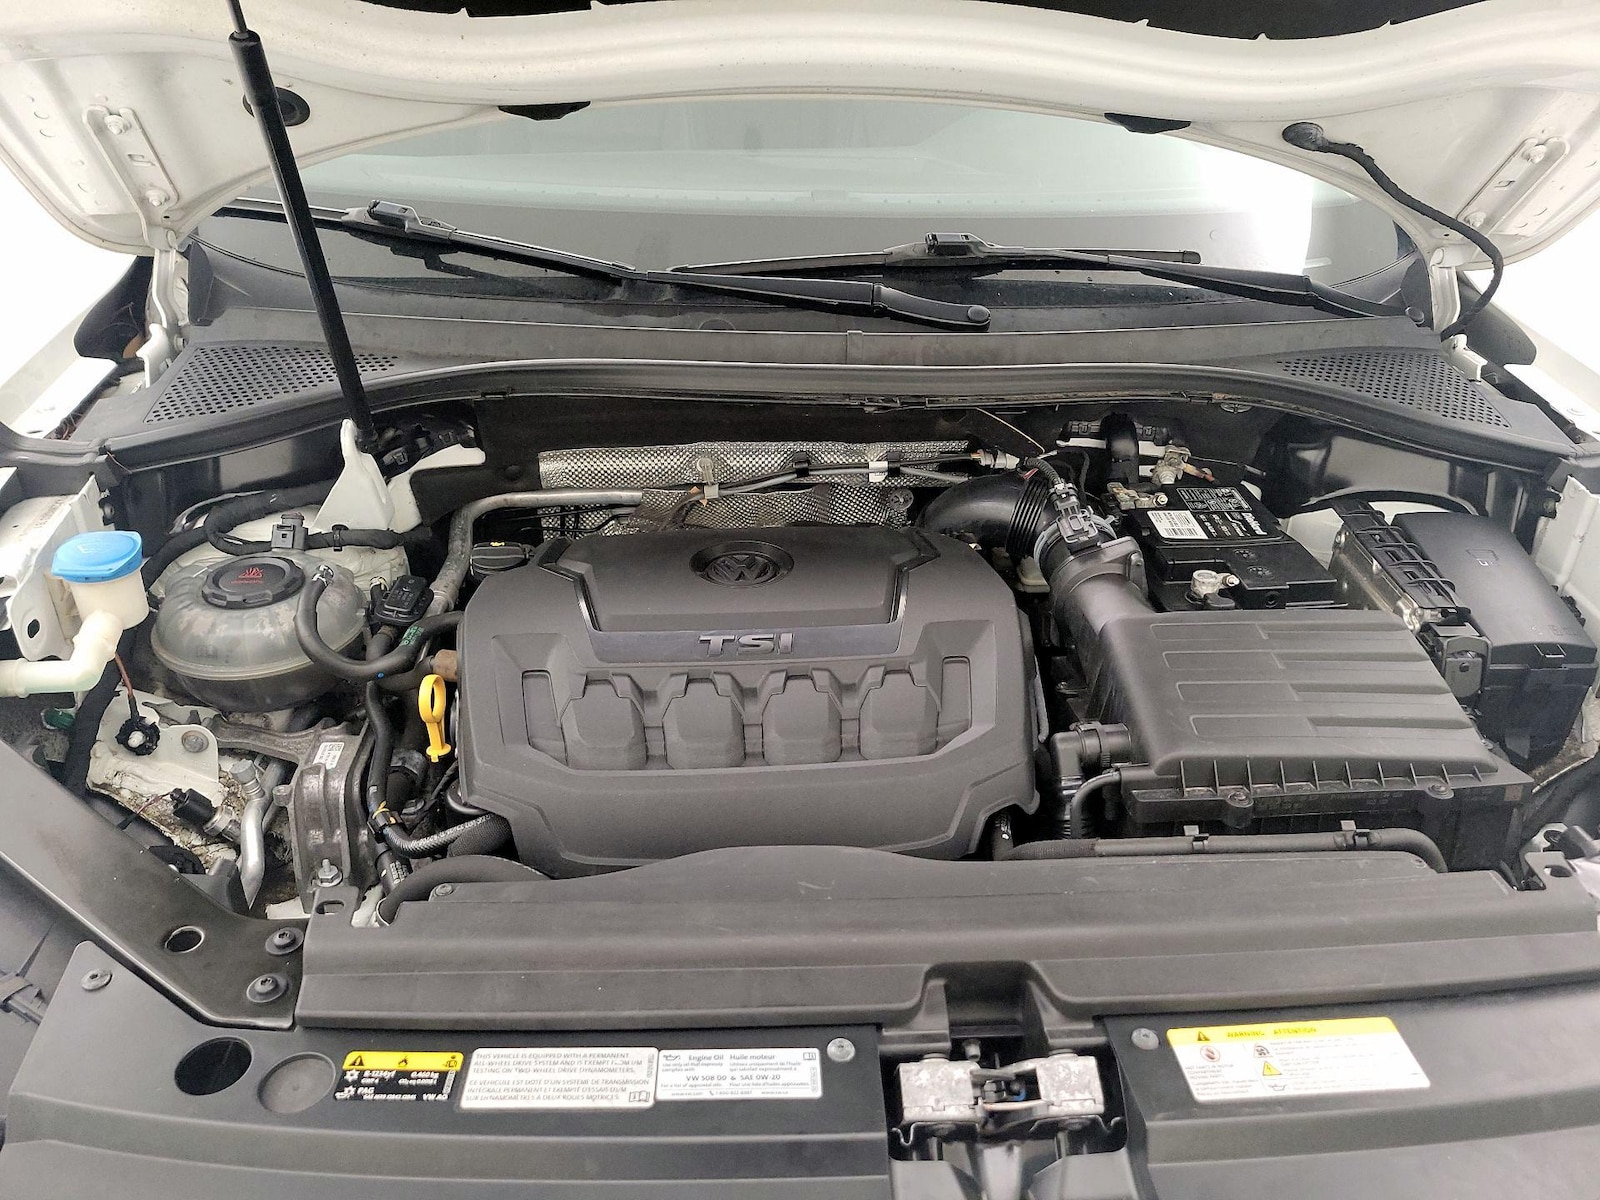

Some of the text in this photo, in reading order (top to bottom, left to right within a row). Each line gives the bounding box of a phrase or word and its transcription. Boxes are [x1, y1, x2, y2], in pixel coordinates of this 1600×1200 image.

[699, 632, 793, 656] TSI
[688, 1054, 712, 1062] Engine
[357, 1087, 375, 1095] PAG
